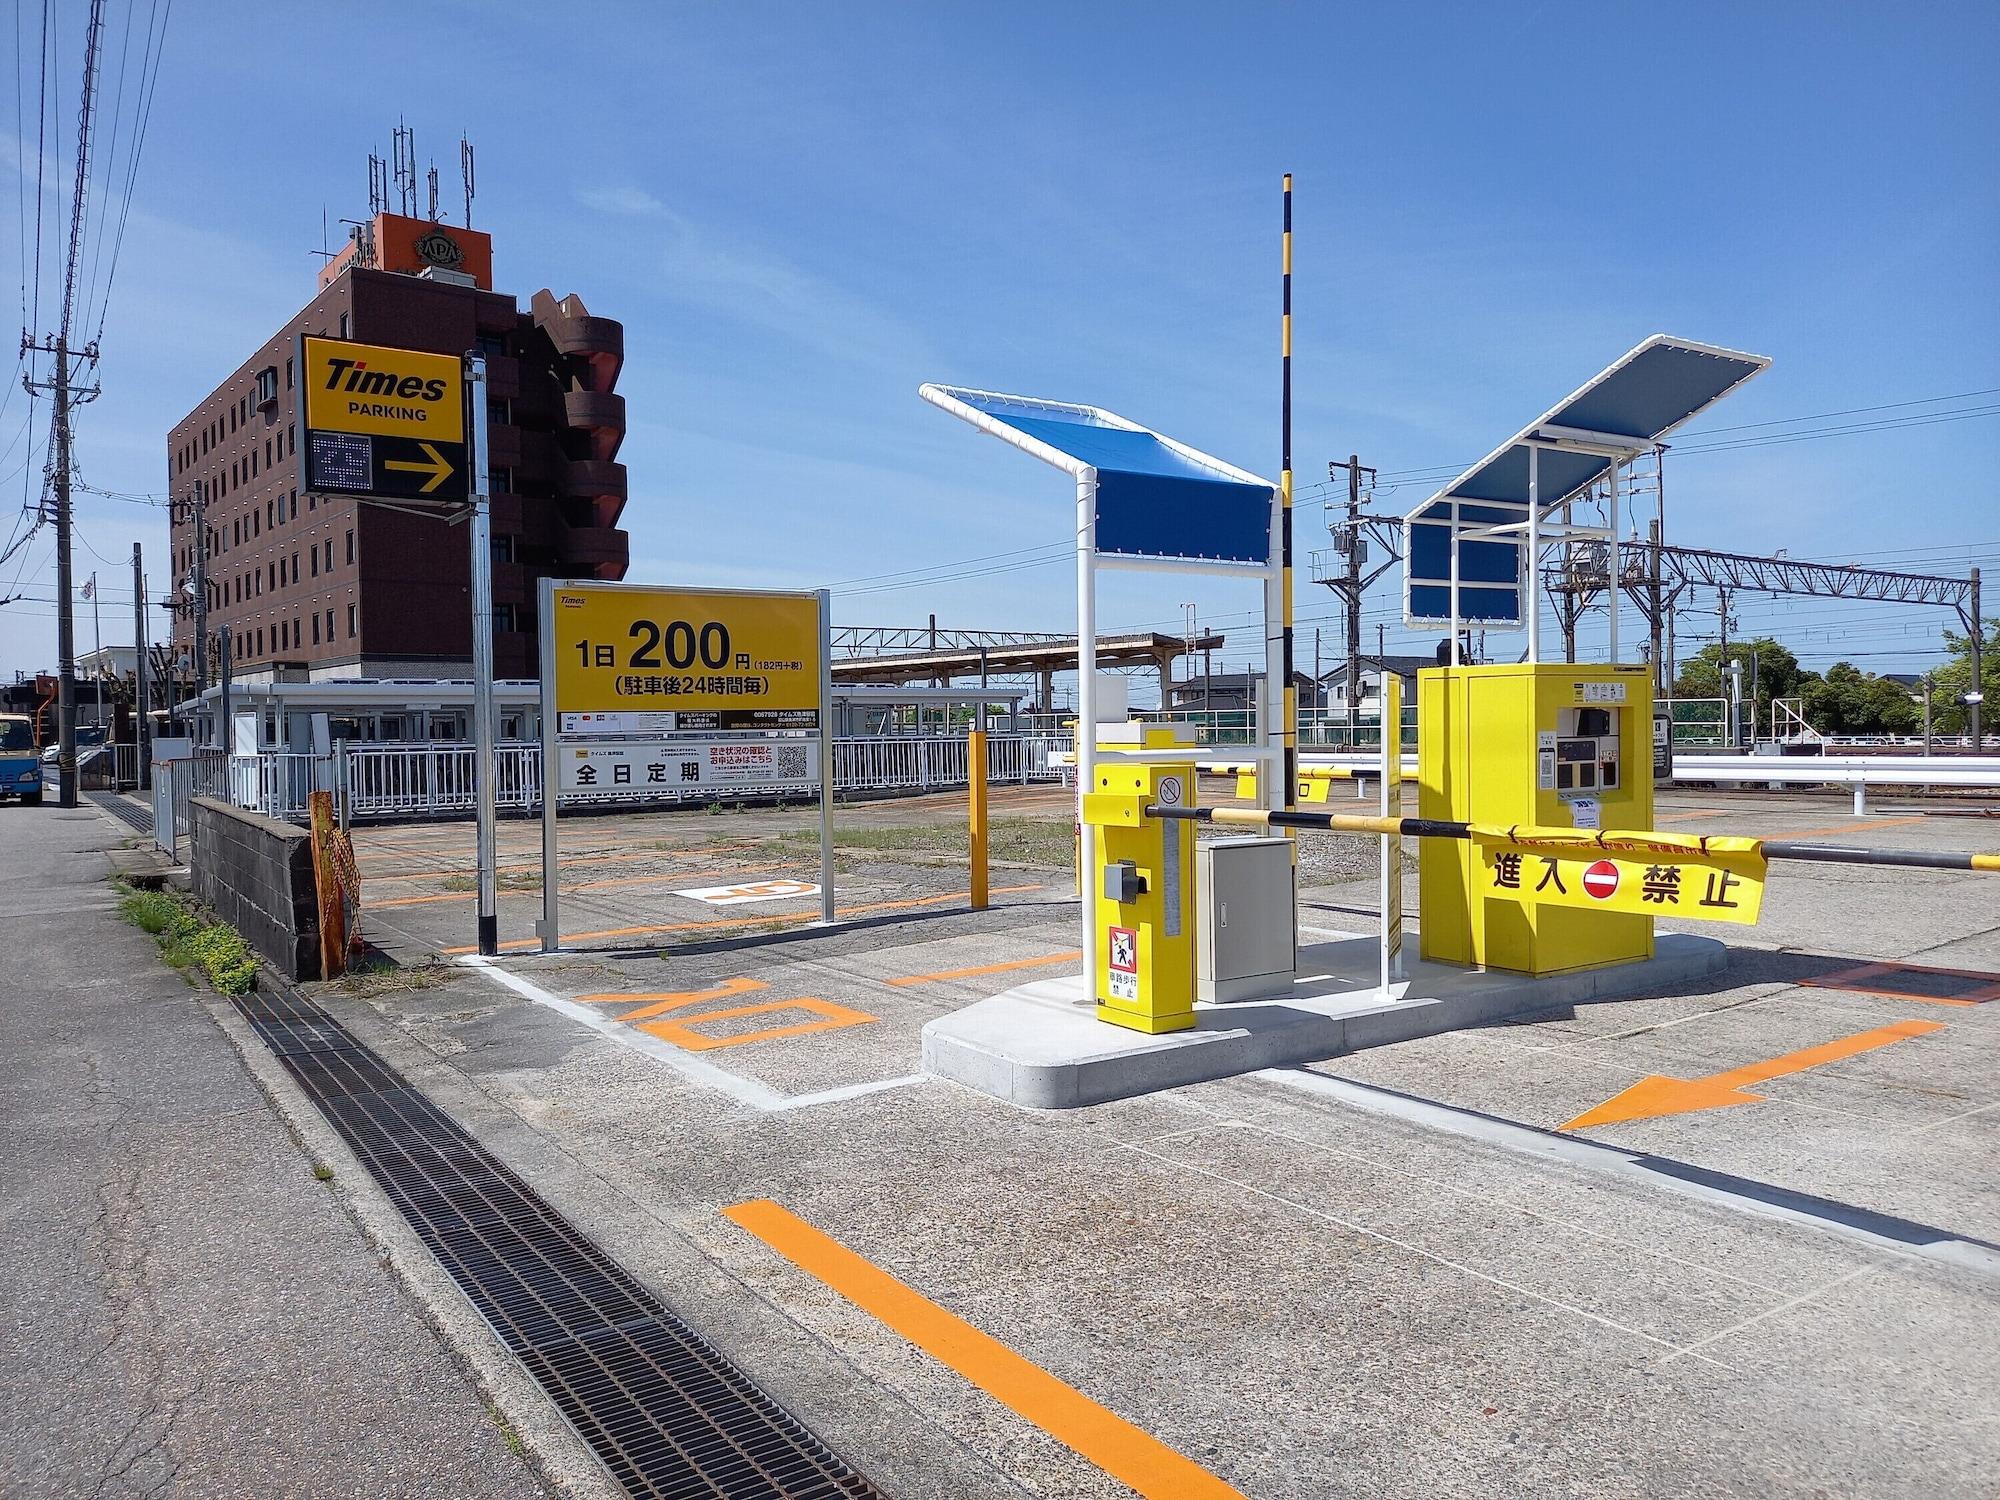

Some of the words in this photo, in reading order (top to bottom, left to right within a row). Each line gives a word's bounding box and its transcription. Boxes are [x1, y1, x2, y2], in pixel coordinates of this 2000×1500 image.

[325, 358, 447, 402] Times
[349, 402, 427, 422] PARKING
[575, 640, 615, 667] 1日
[628, 619, 730, 670] 200
[735, 653, 750, 670] 円
[576, 762, 700, 785] 全日定期
